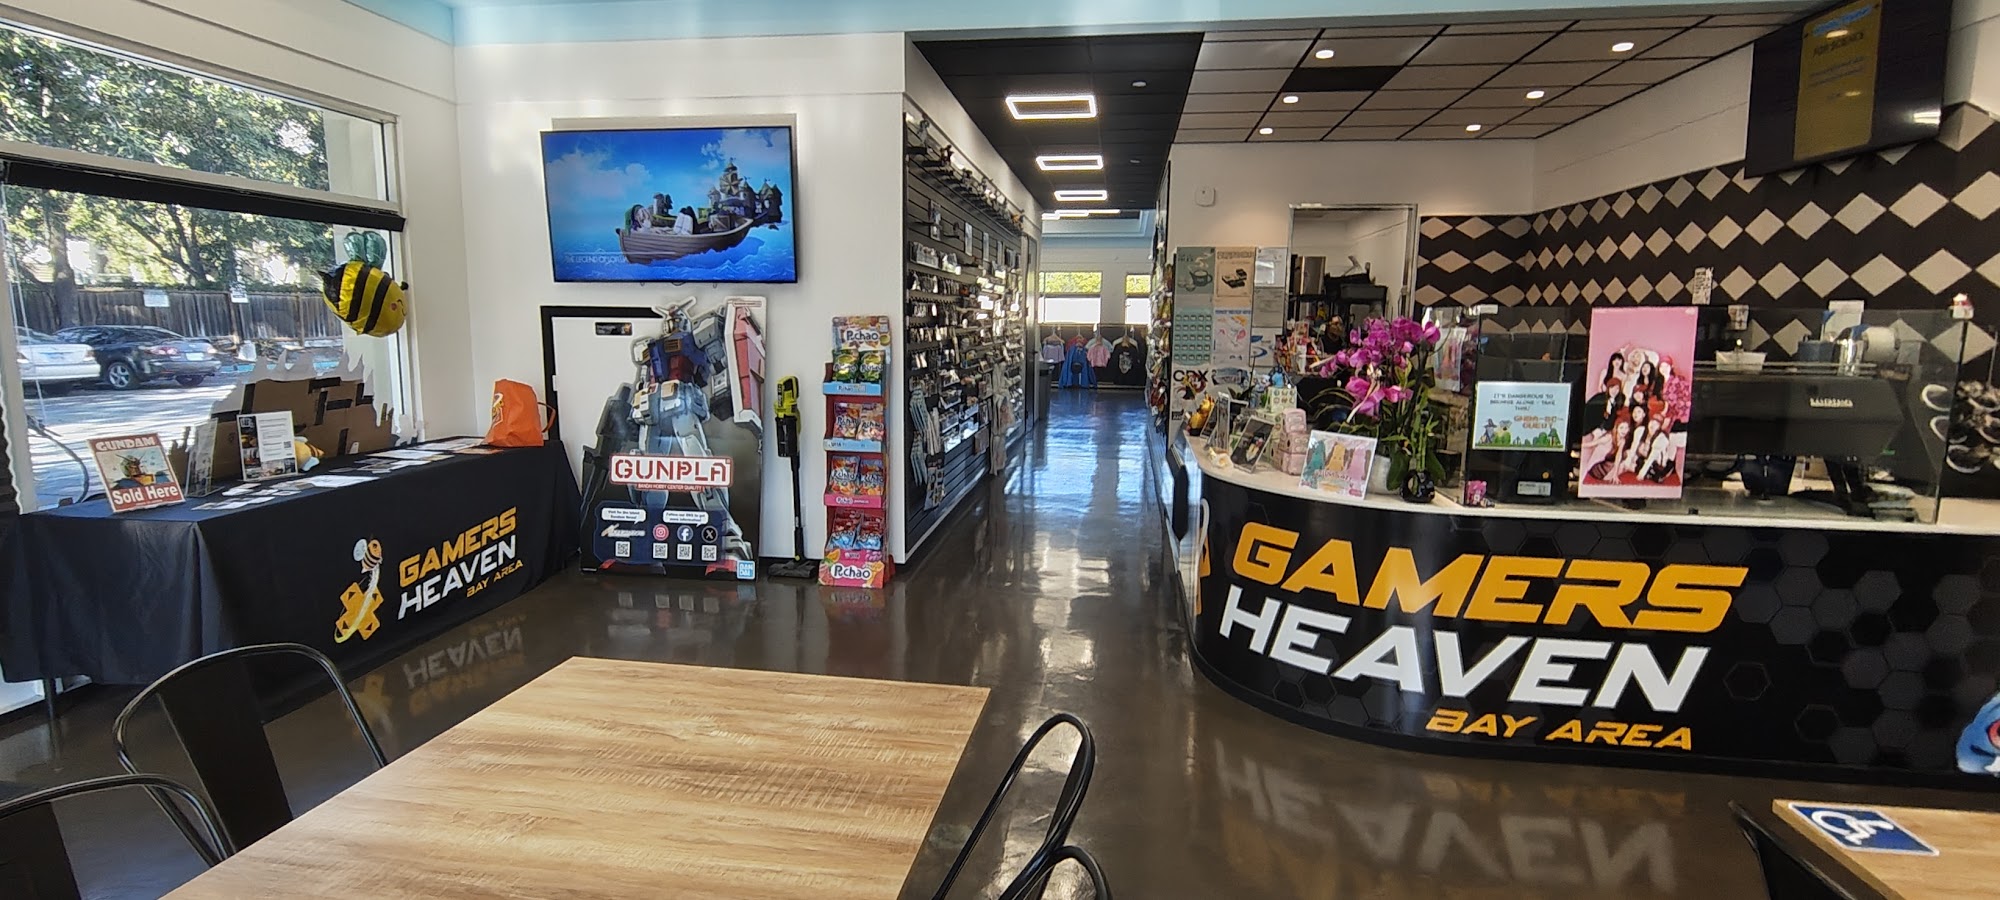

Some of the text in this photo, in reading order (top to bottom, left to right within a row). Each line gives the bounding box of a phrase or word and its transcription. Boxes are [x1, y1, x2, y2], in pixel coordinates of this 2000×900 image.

[95, 437, 156, 451] GUNDAM
[615, 460, 726, 482] GUNPLA
[112, 485, 179, 505] Sold Here
[399, 506, 517, 588] GAMERS
[398, 535, 516, 620] HEAVEN
[466, 559, 524, 598] BAY AREA
[1232, 521, 1749, 633] GAMERS
[1218, 584, 1712, 713] HEAVEN
[1425, 708, 1692, 750] BAY AREA
